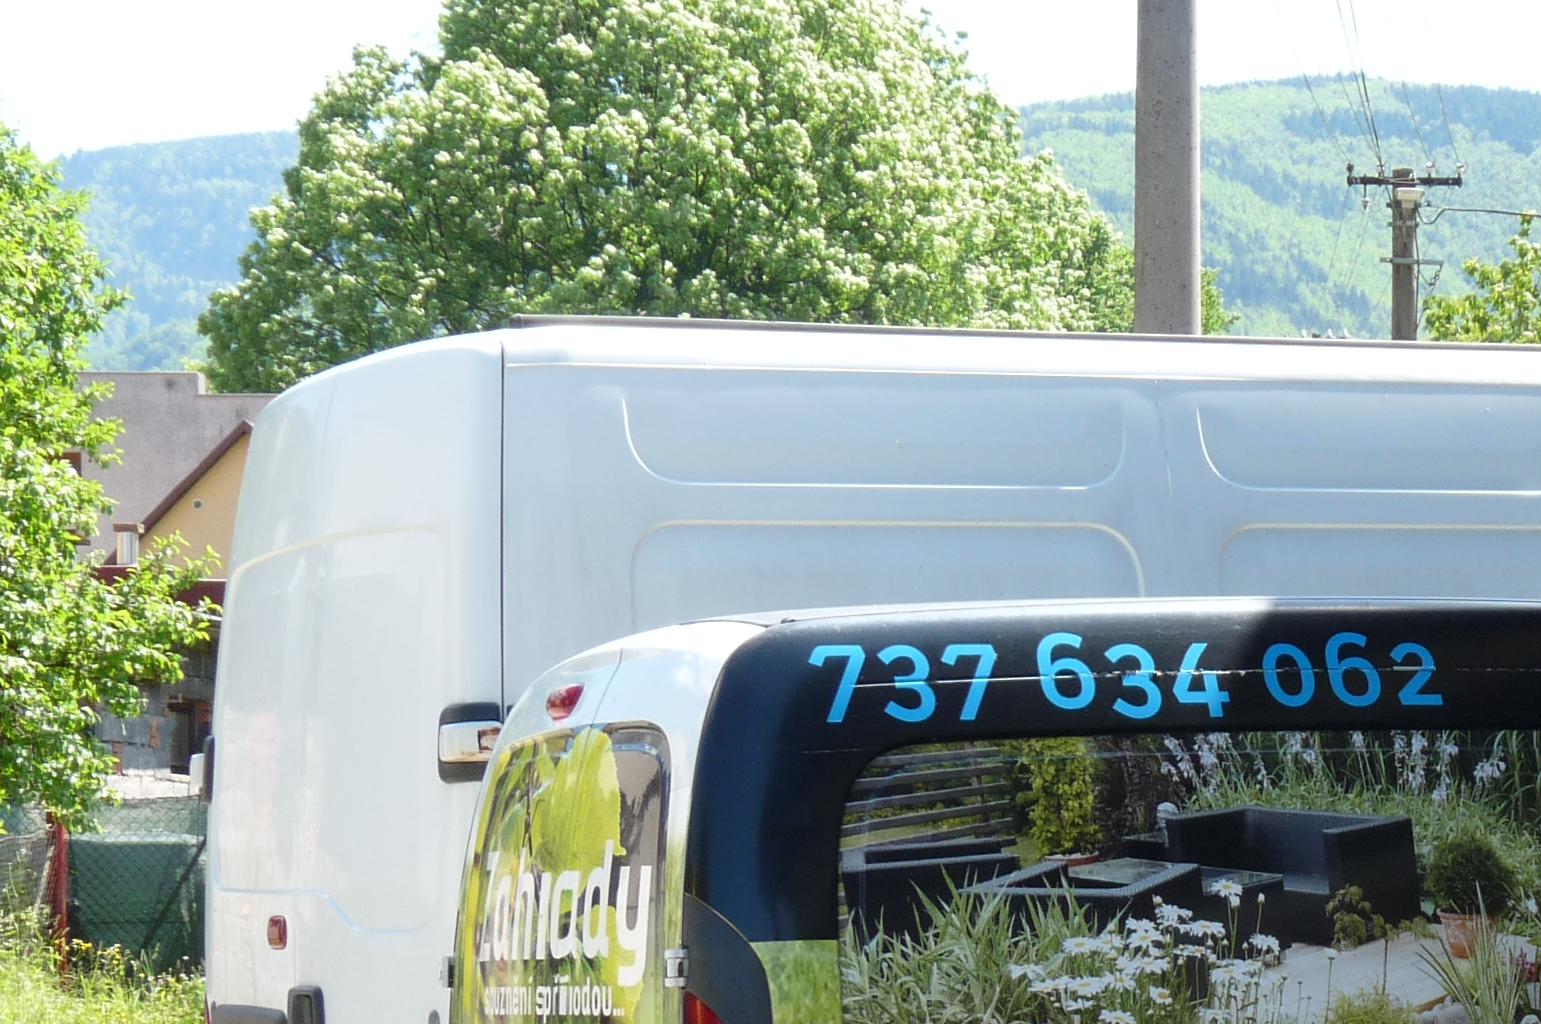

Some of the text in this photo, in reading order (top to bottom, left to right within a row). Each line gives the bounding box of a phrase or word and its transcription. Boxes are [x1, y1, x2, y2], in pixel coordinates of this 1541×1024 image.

[808, 631, 1445, 724] 737 634 062
